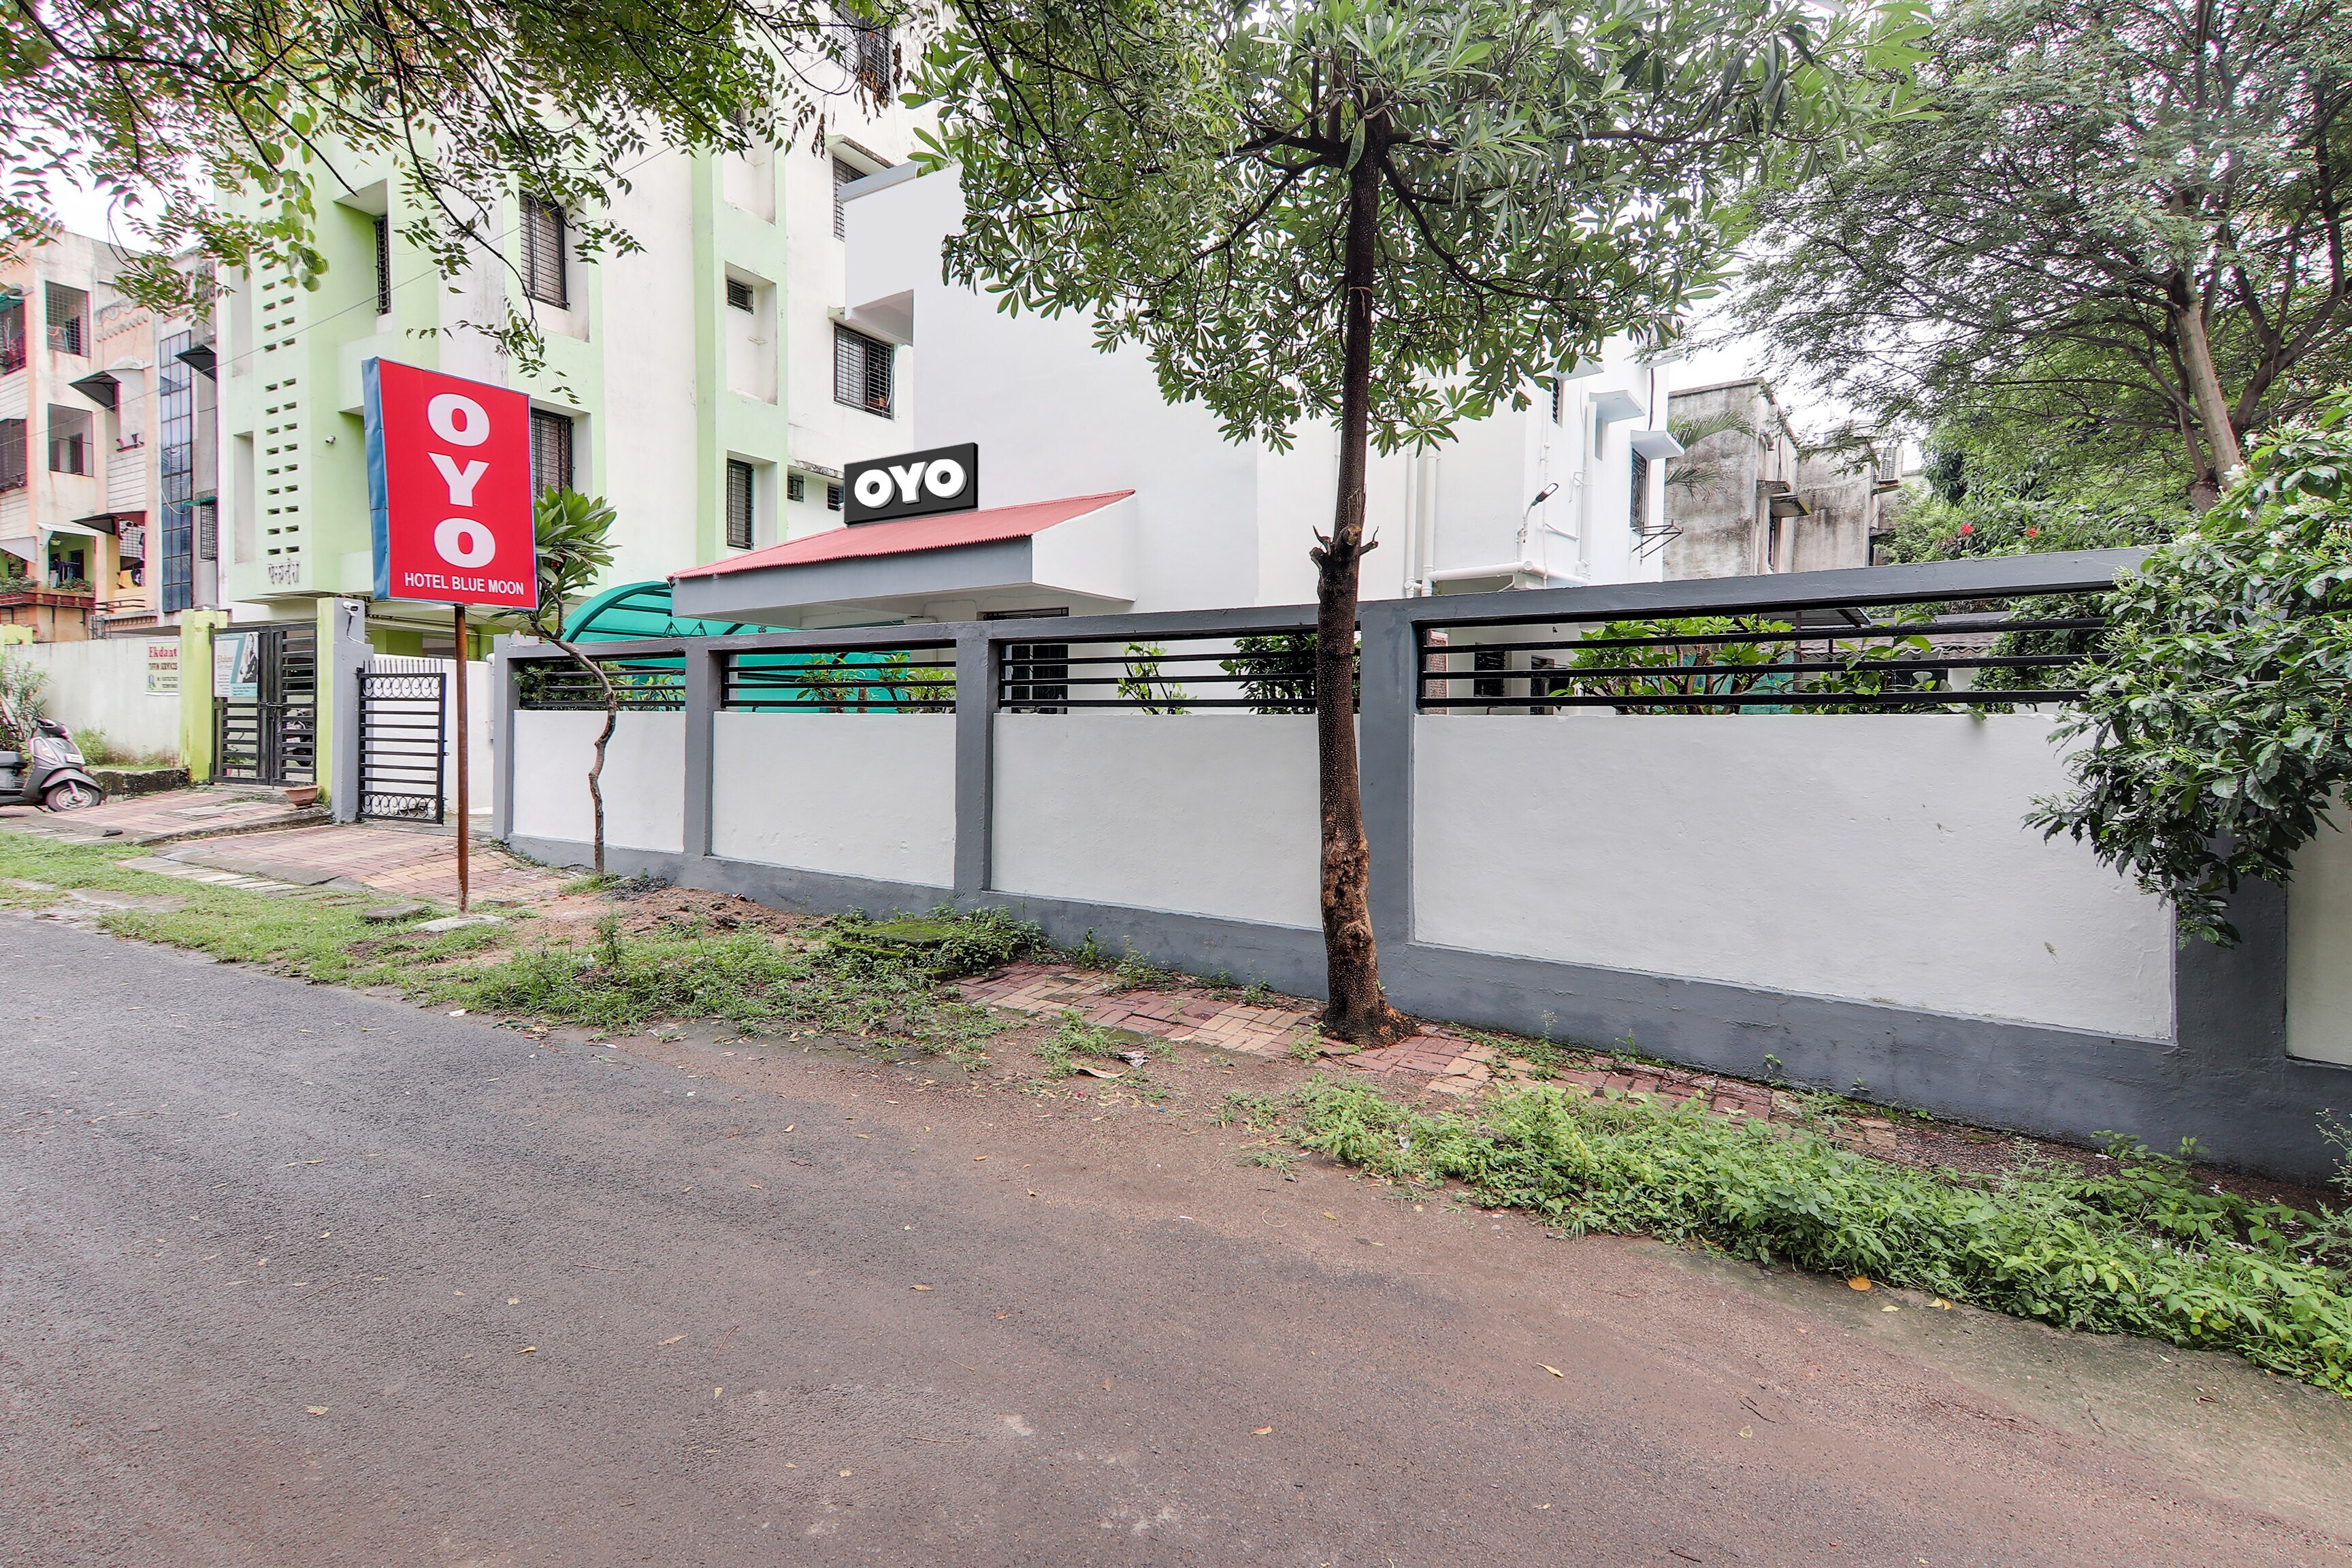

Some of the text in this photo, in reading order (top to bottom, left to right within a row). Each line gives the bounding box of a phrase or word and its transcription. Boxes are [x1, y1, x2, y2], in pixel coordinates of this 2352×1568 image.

[427, 393, 495, 568] OYO
[854, 459, 968, 509] OYO
[404, 572, 524, 595] HOTEL BLUE MOON
[148, 646, 178, 657] Ekdant
